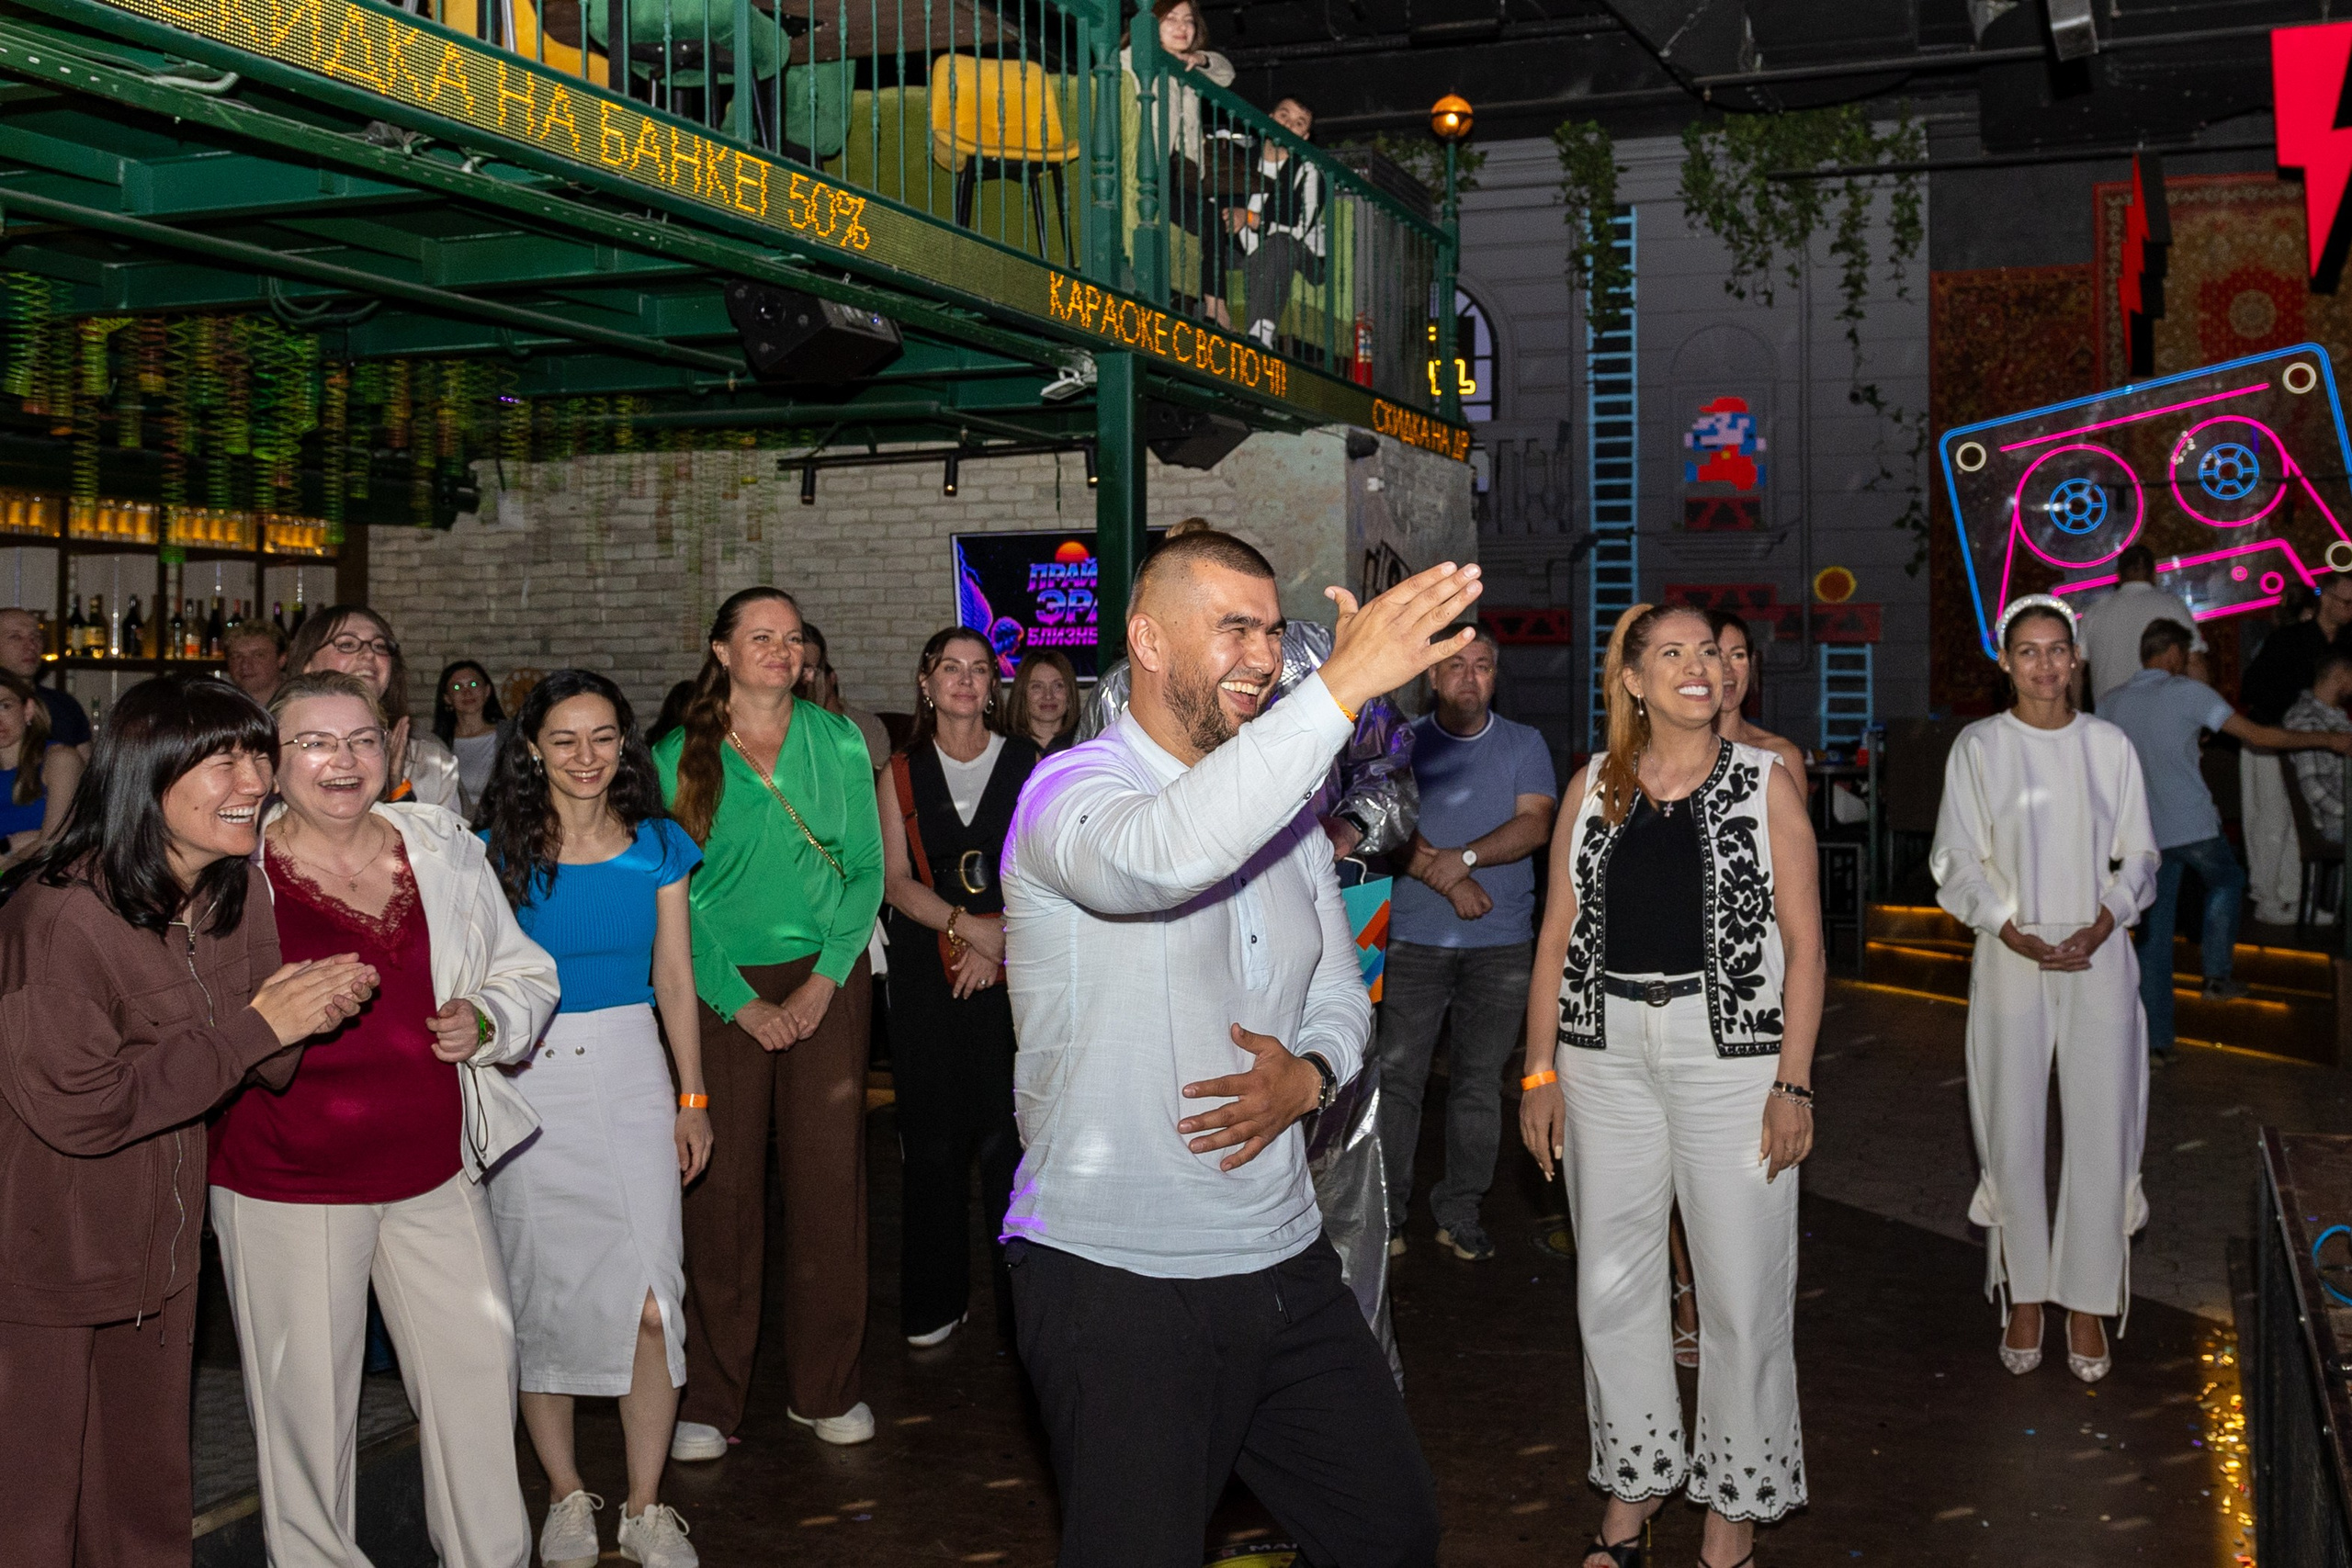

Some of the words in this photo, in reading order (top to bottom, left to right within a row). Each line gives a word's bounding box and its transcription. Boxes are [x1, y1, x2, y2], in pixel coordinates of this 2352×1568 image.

[498, 61, 581, 153] НА
[600, 100, 772, 217] БАНКЕТ
[788, 172, 871, 251] 50%
[1049, 271, 1168, 355] КАРАОКЕ
[1172, 321, 1193, 363] С
[1195, 328, 1226, 376] ВС
[1230, 342, 1260, 388] ПО
[1373, 397, 1430, 449] СКИДКА
